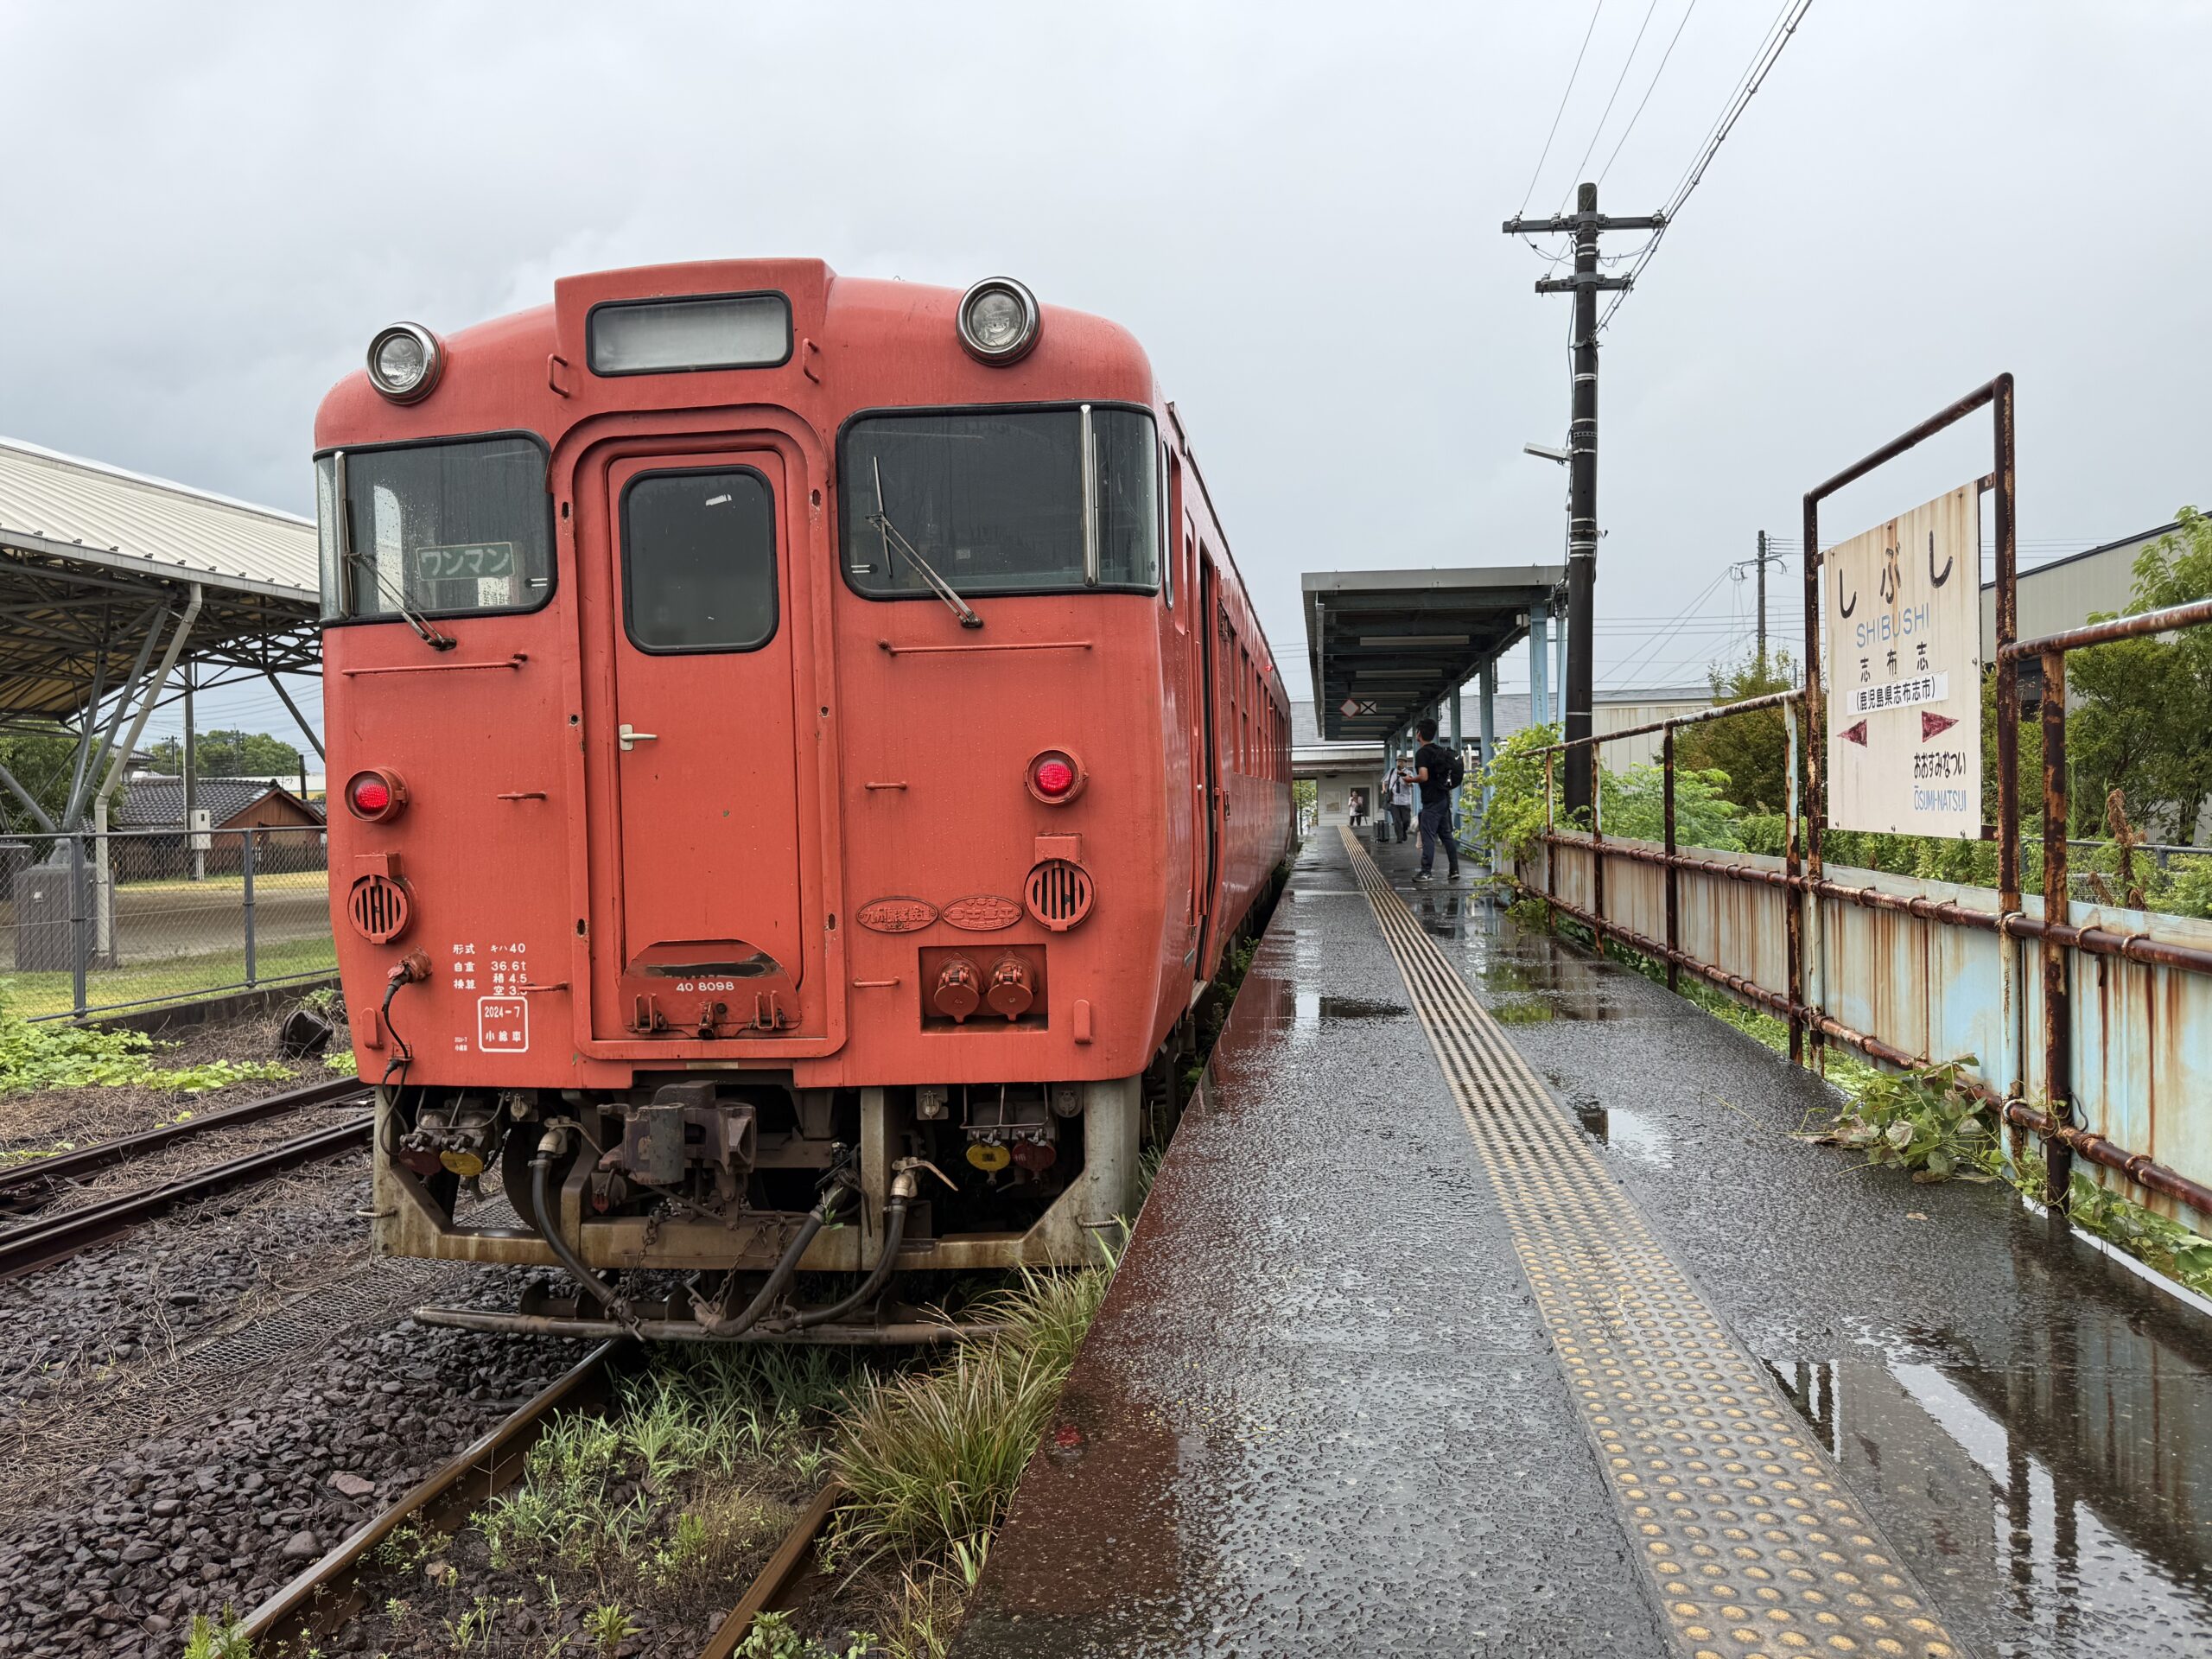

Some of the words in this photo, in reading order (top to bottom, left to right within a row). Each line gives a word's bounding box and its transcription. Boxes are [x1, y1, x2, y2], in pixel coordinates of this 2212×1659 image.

[421, 548, 510, 576] ワンマン
[1839, 530, 1954, 620] しぶし
[1856, 601, 1929, 648] SHIBUSHI
[1860, 641, 1929, 683] 志布志
[1856, 676, 1936, 712] (鹿児島県志布志市)
[1913, 750, 1967, 779] おおすみなつい
[453, 944, 475, 954] 形式
[454, 961, 475, 973] 自重
[491, 961, 526, 971] 36.6t
[509, 974, 527, 983] 4.5
[493, 985, 505, 996] 空
[676, 982, 694, 992] 40
[698, 982, 734, 992] 8098
